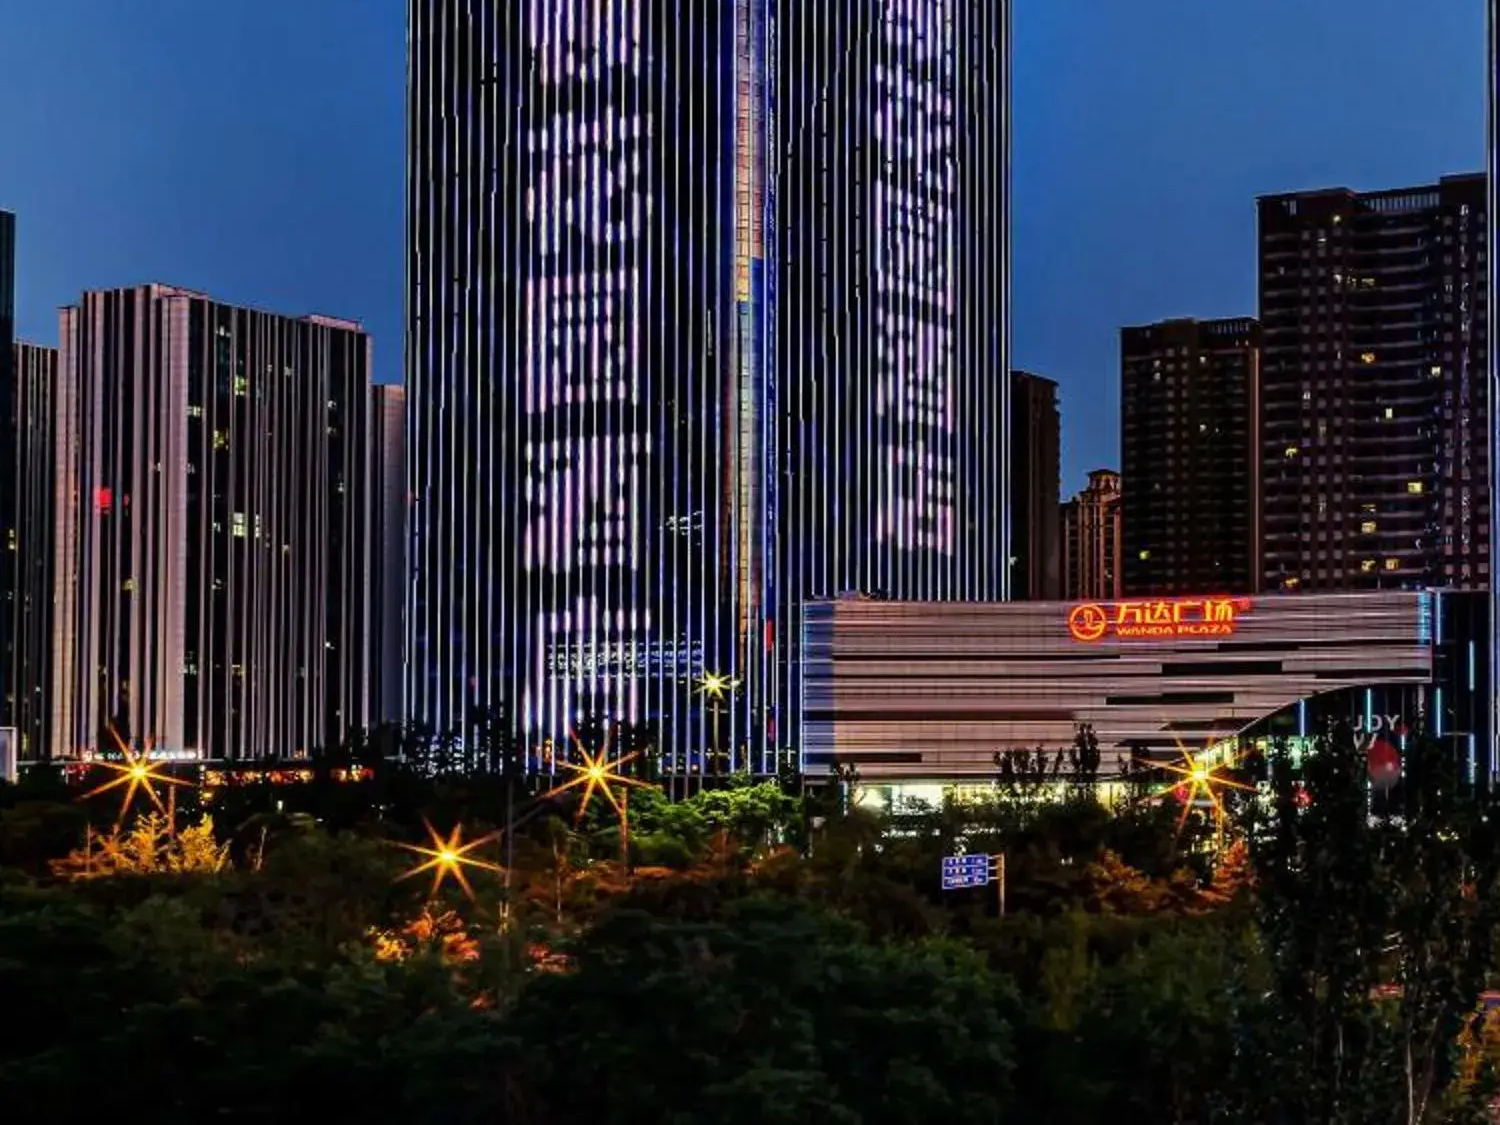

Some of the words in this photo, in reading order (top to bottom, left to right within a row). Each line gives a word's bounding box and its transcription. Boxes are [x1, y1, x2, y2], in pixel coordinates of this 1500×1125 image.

[1117, 600, 1233, 624] 万达广场
[1117, 625, 1173, 636] WANDA
[1352, 714, 1400, 732] JOY
